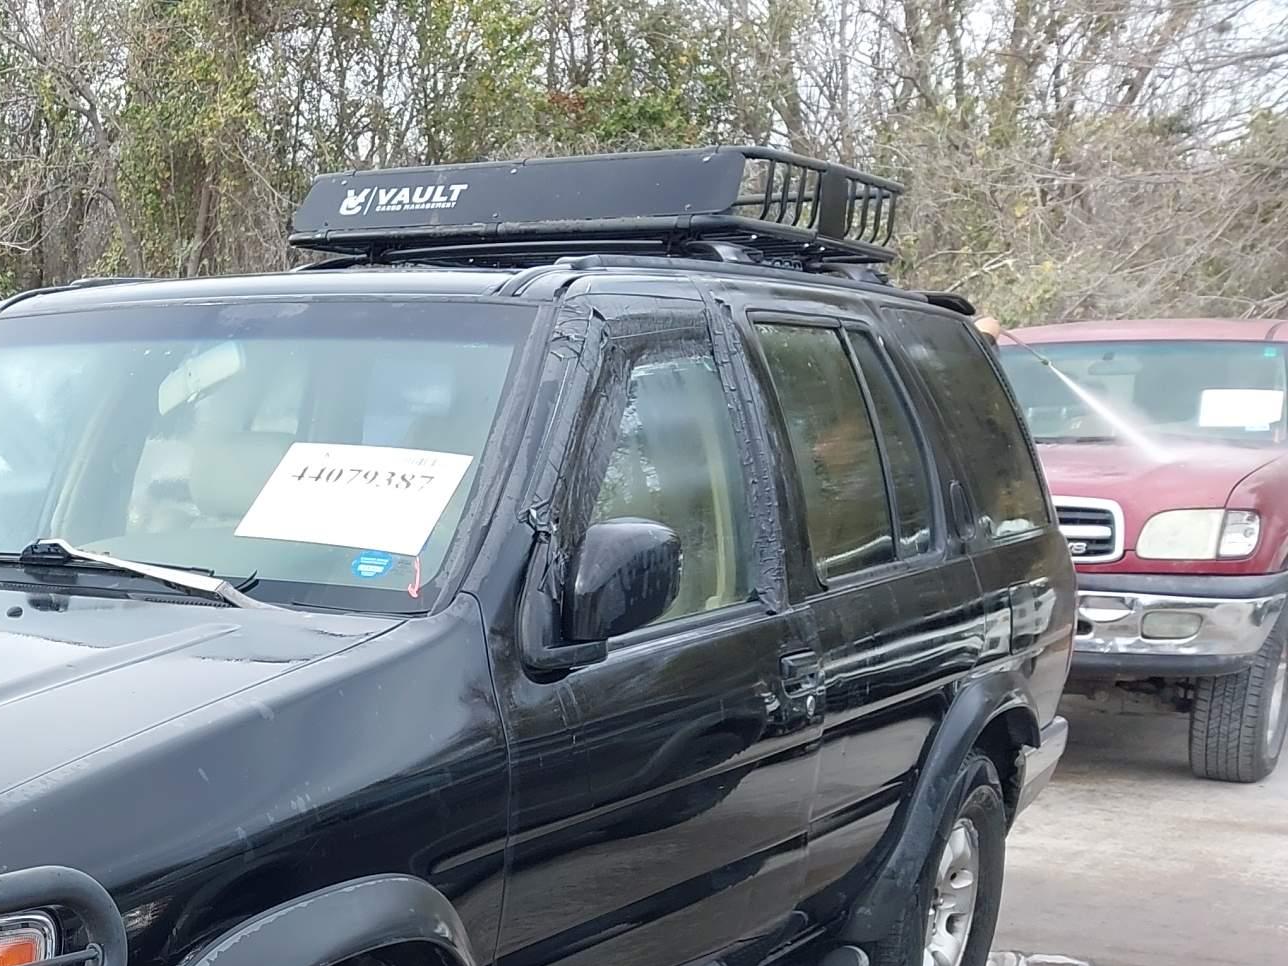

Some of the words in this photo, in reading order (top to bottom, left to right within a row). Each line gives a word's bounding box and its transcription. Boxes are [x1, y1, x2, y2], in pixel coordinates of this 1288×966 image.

[377, 184, 469, 205] VAULT
[403, 201, 457, 211] MANAGEMENT
[291, 466, 436, 491] 44079387
